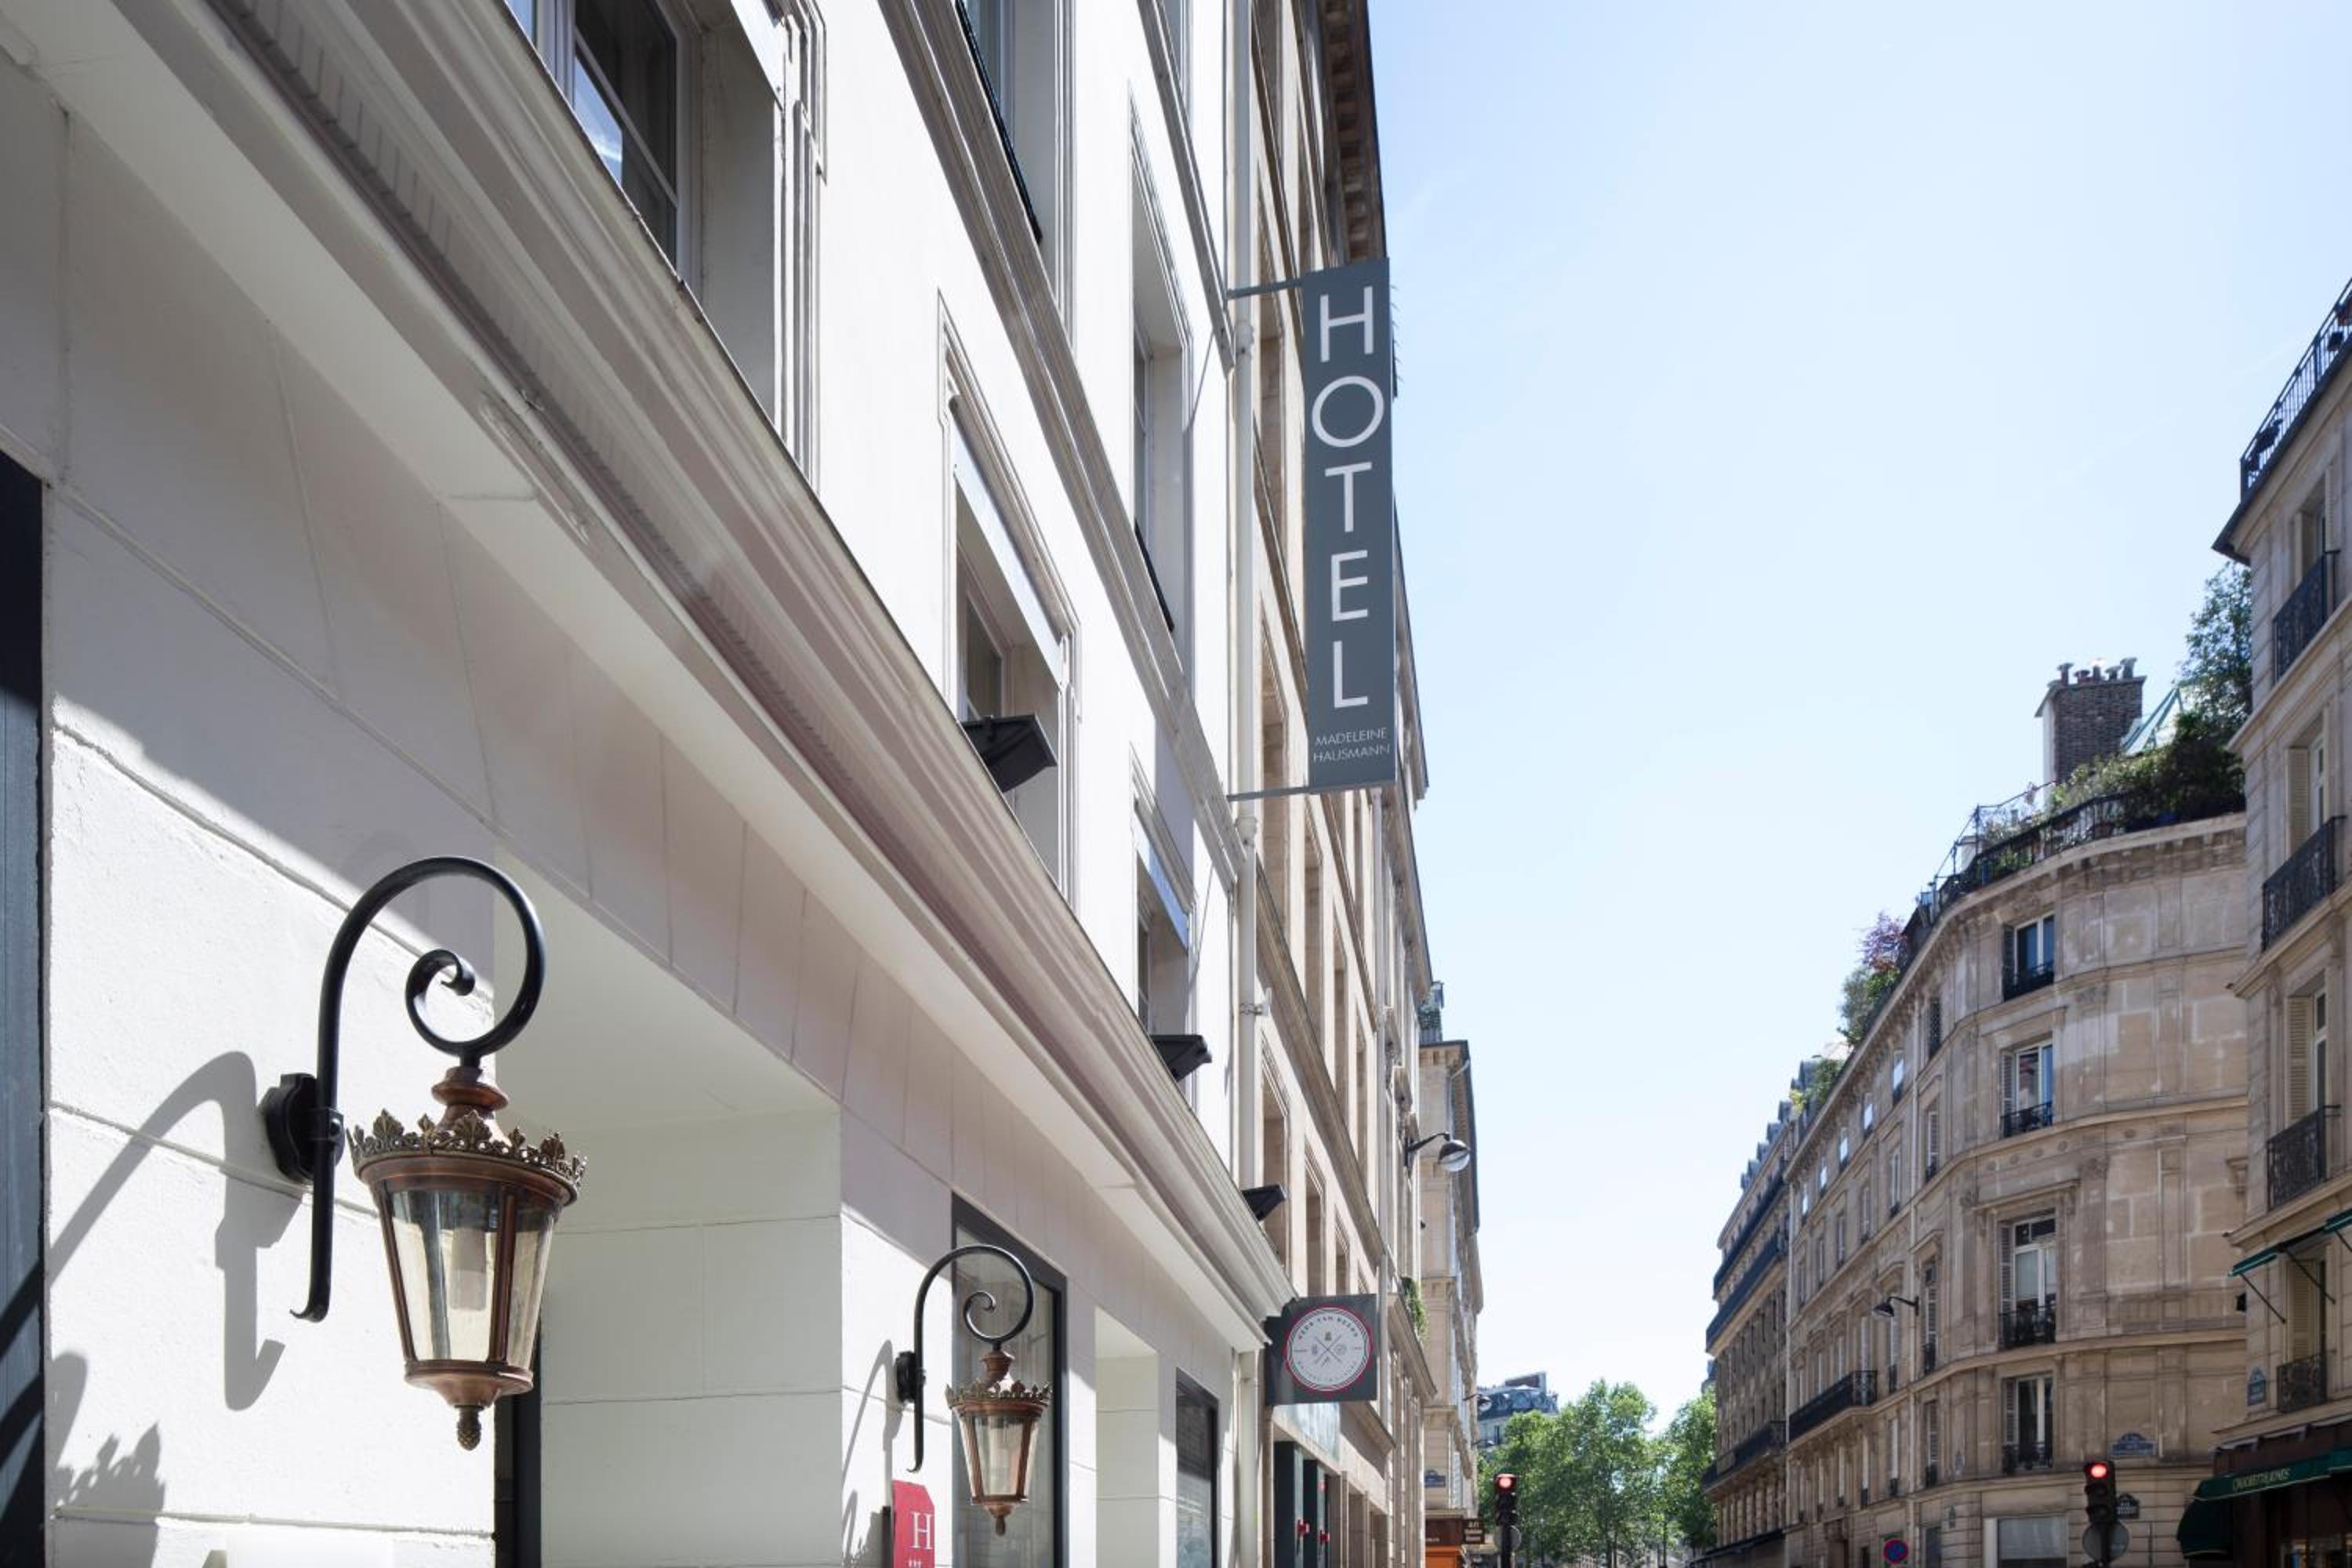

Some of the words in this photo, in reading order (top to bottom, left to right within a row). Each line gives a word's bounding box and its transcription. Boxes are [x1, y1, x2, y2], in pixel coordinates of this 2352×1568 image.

[1312, 285, 1385, 709] HOTEL
[1315, 728, 1387, 746] MADELEINE
[909, 1512, 933, 1549] H
